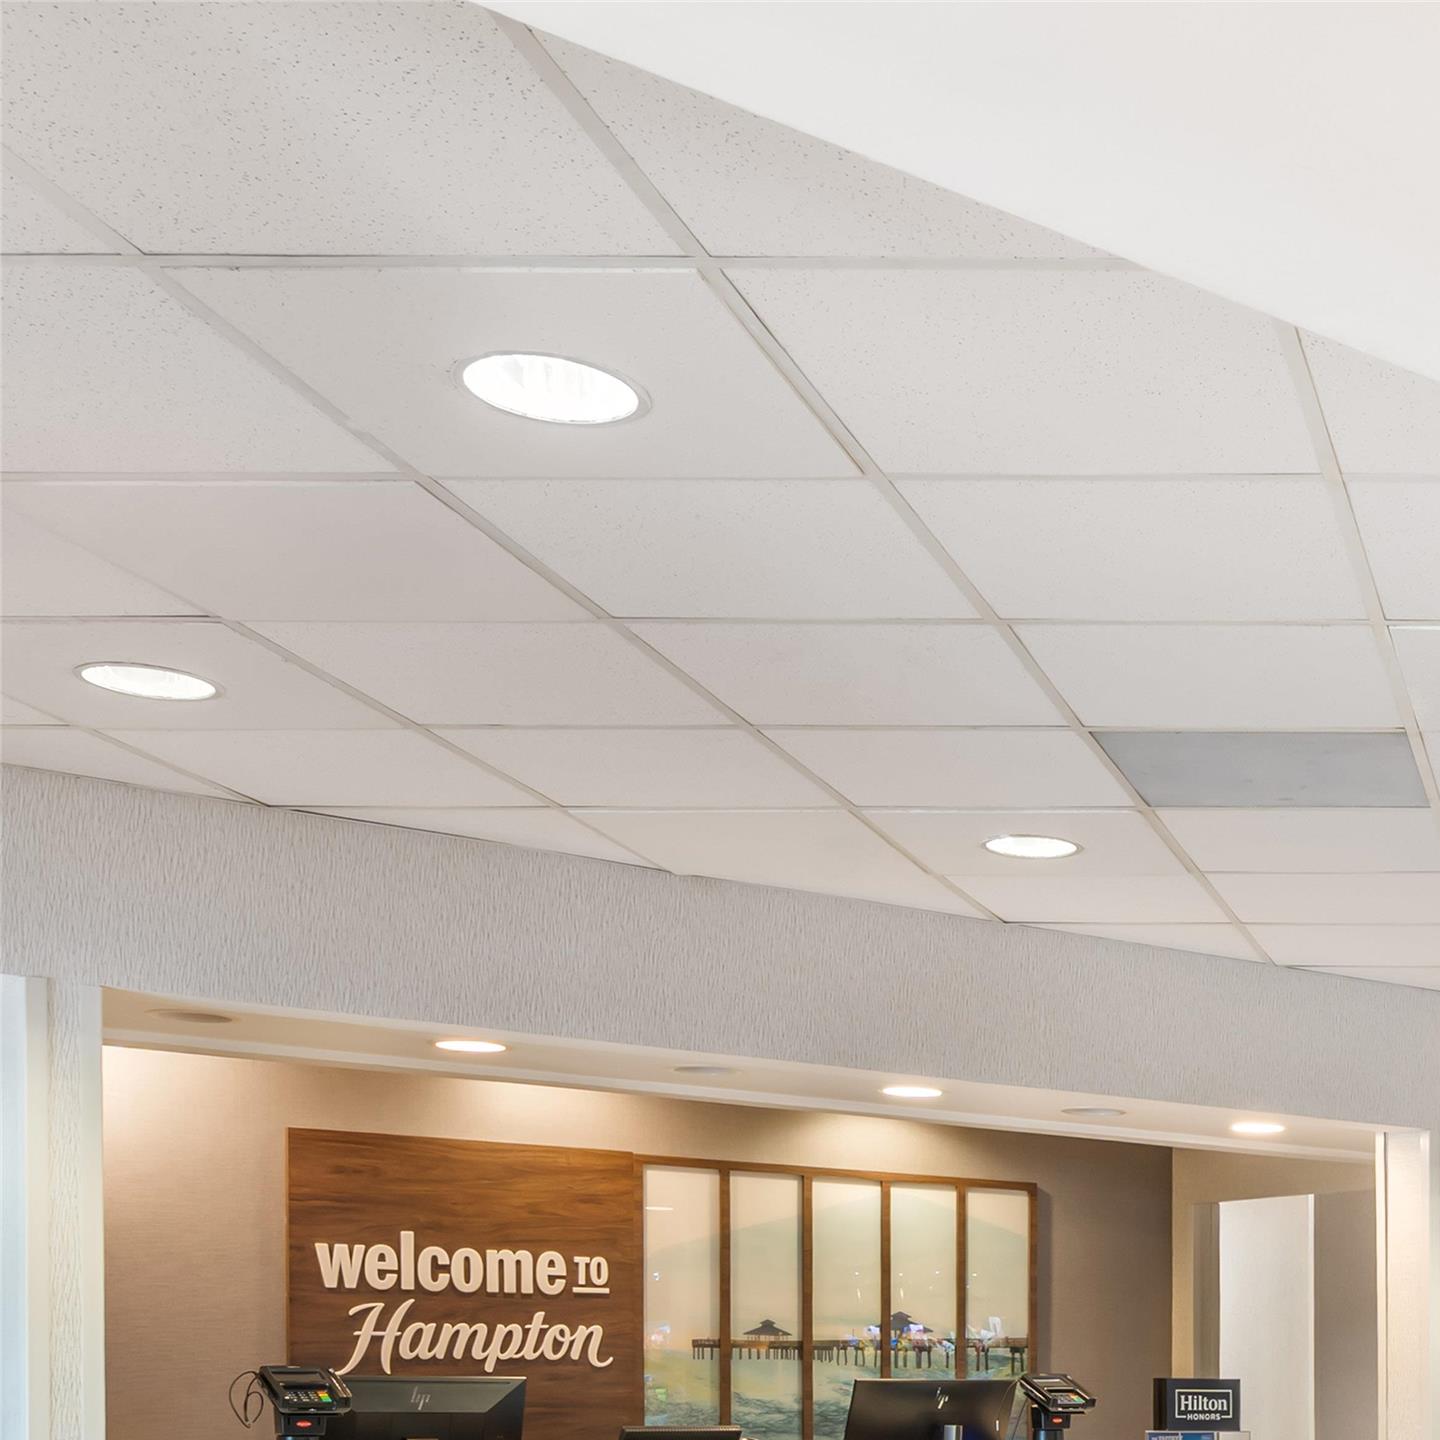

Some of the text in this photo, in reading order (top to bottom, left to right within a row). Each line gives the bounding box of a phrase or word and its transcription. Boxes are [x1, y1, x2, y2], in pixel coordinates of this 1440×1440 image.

[314, 1230, 610, 1296] welcome TO
[334, 1298, 614, 1376] Hampton
[1179, 1394, 1228, 1412] Hilton
[1186, 1413, 1221, 1421] HONORS
